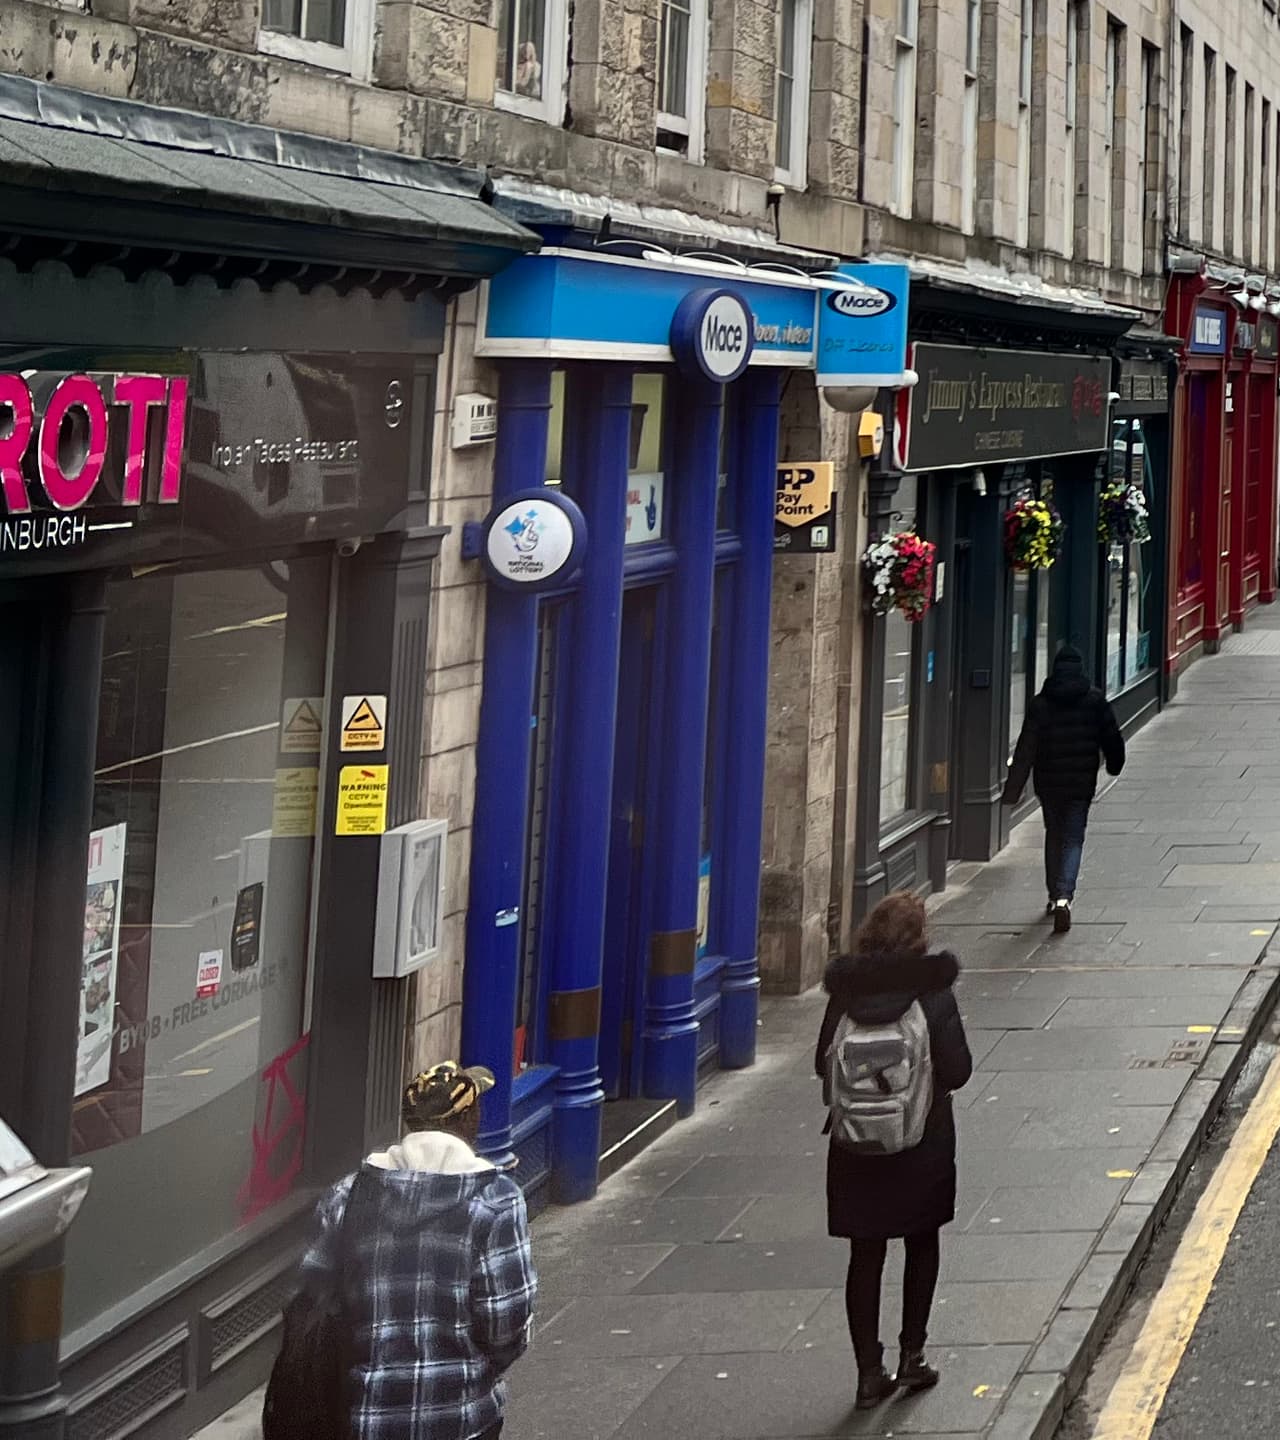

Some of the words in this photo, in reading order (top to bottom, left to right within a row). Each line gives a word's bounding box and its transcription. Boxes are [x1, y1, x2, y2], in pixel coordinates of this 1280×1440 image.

[839, 295, 884, 309] Mace
[704, 313, 743, 353] Mace
[978, 371, 1023, 422] Express
[0, 372, 190, 513] ROTI
[776, 503, 814, 515] Point
[777, 492, 802, 506] Pay
[0, 517, 86, 551] INBURGH
